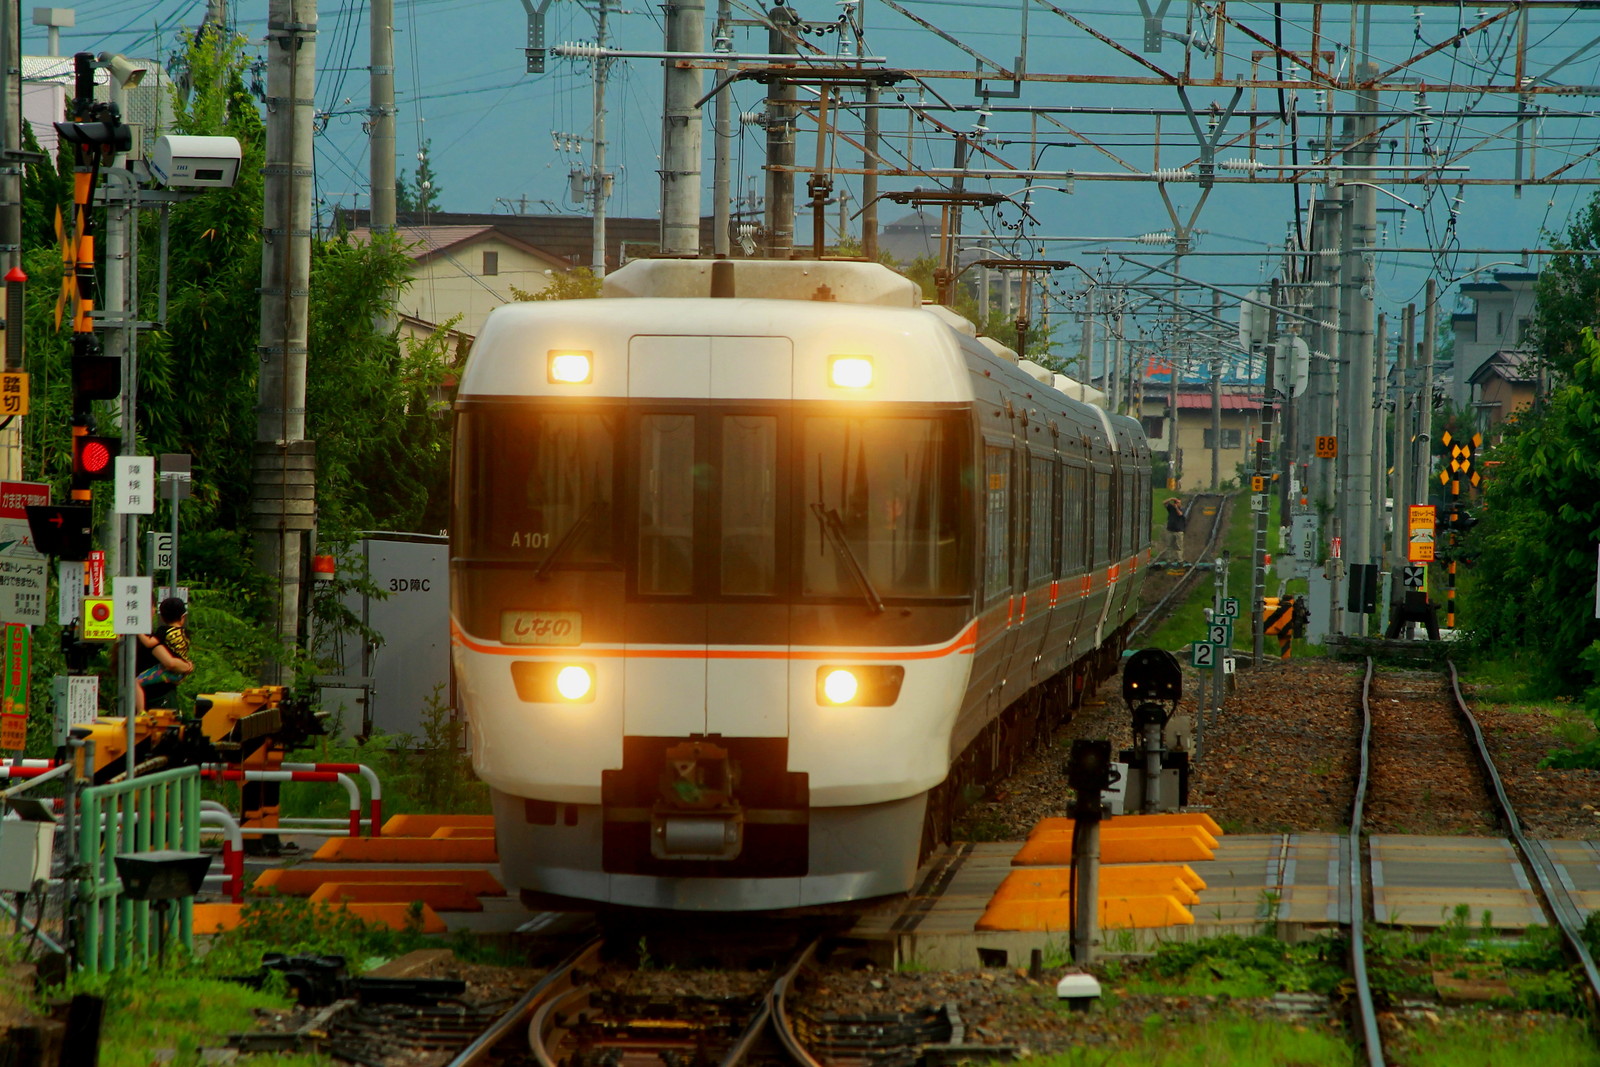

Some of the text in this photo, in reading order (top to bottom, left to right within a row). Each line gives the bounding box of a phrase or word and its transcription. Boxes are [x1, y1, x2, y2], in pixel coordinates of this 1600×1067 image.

[4, 376, 21, 412] 踏切
[1319, 437, 1335, 451] 88
[128, 464, 141, 505] 障検用
[126, 584, 138, 626] 障検用
[1226, 601, 1236, 616] 5
[513, 617, 573, 637] しなの
[1212, 626, 1225, 644] 3
[1197, 644, 1211, 665] 2
[1225, 659, 1232, 673] 1
